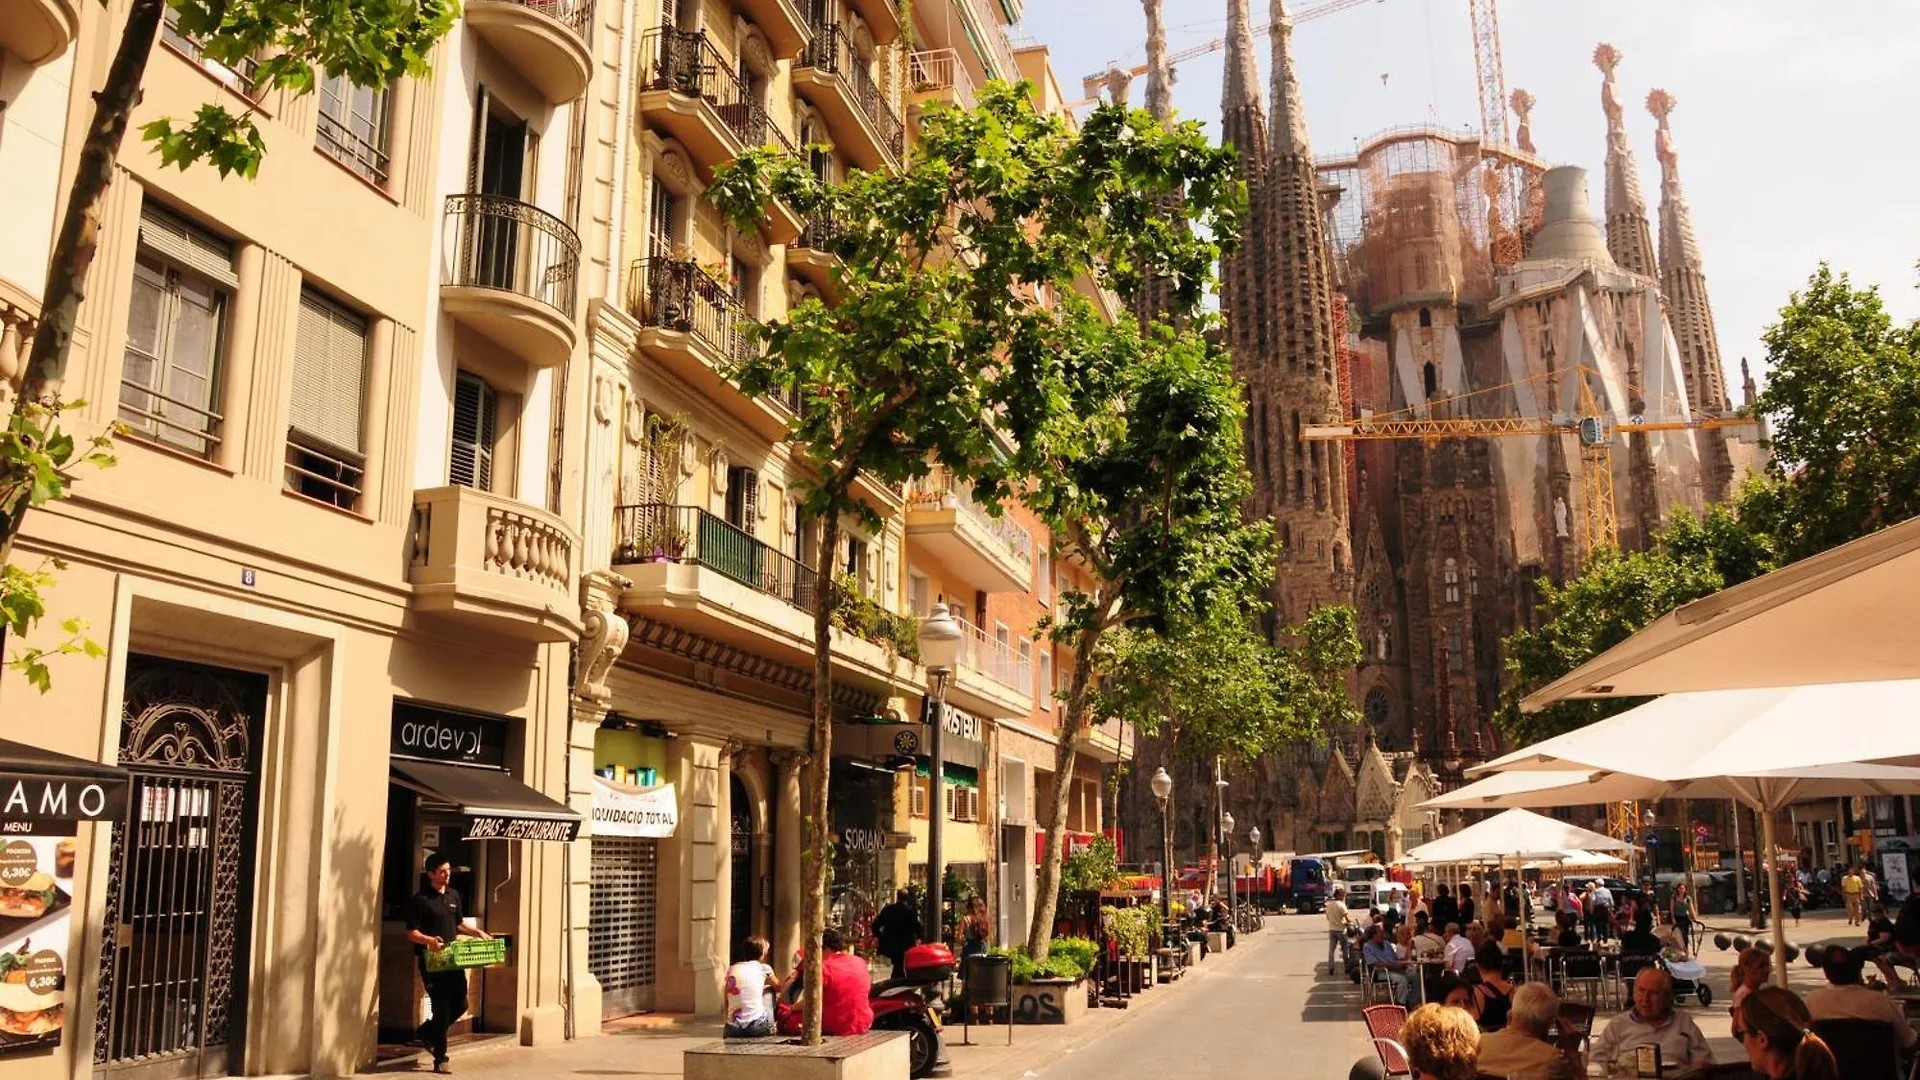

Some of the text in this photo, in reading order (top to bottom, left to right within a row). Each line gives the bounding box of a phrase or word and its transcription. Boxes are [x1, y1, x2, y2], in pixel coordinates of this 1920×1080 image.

[245, 570, 252, 584] 8
[645, 811, 674, 825] TOTAL
[3, 822, 33, 833] MENU
[469, 818, 504, 837] TAPAS
[504, 820, 572, 841] RESTAURANTE
[844, 827, 887, 850] SORIANO
[2, 867, 32, 880] 6,30€
[29, 976, 58, 989] 6,30€
